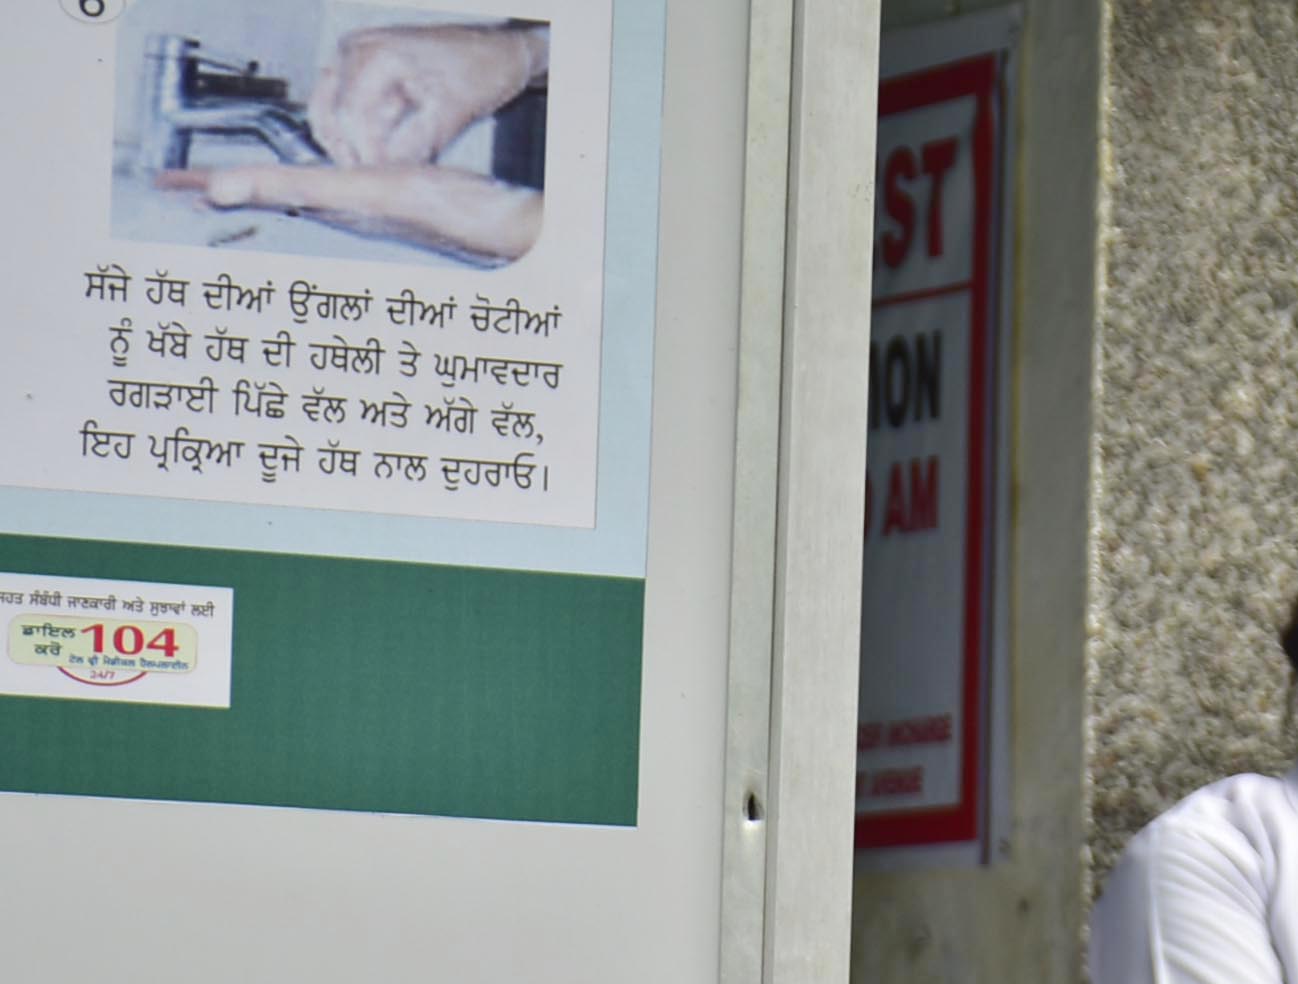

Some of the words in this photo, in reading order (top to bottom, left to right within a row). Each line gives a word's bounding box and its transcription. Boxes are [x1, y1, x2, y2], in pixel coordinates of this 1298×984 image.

[872, 135, 958, 270] ST
[84, 264, 132, 301] ਸੱਜੇ
[145, 269, 190, 306] ਹੱਥ
[202, 273, 276, 312] ਦੀਆਂ
[386, 289, 457, 328] ਦੀਆਂ
[470, 293, 562, 336] ਚੋਟੀਆਂ
[109, 317, 133, 367] ਨੂੰ
[146, 321, 191, 359] ਖੱਬੇ
[204, 326, 249, 363] ਹੱਥ
[261, 330, 296, 367] ਦੀ
[308, 335, 386, 375] ਹਥੇਲੀ
[398, 341, 421, 377] ਤੇ
[434, 353, 564, 389] ਘੁਮਾਵਦਾਰ
[107, 376, 219, 414] ਰਗੜਾਈ
[232, 379, 289, 419] ਪਿੱਛੇ
[301, 385, 348, 424] ਵੱਲ
[359, 391, 412, 428] ਅਤੇ
[424, 396, 478, 434] ਅੱਗੇ
[491, 401, 544, 445] ਵੱਲ,
[79, 419, 136, 459] ਇਹ
[257, 435, 304, 484] ਦੂਜੇ
[317, 438, 361, 477] ਹੱਥ
[373, 452, 428, 482] ਨਾਲ
[122, 596, 145, 613] ਅਤੇ
[80, 623, 180, 657] 104
